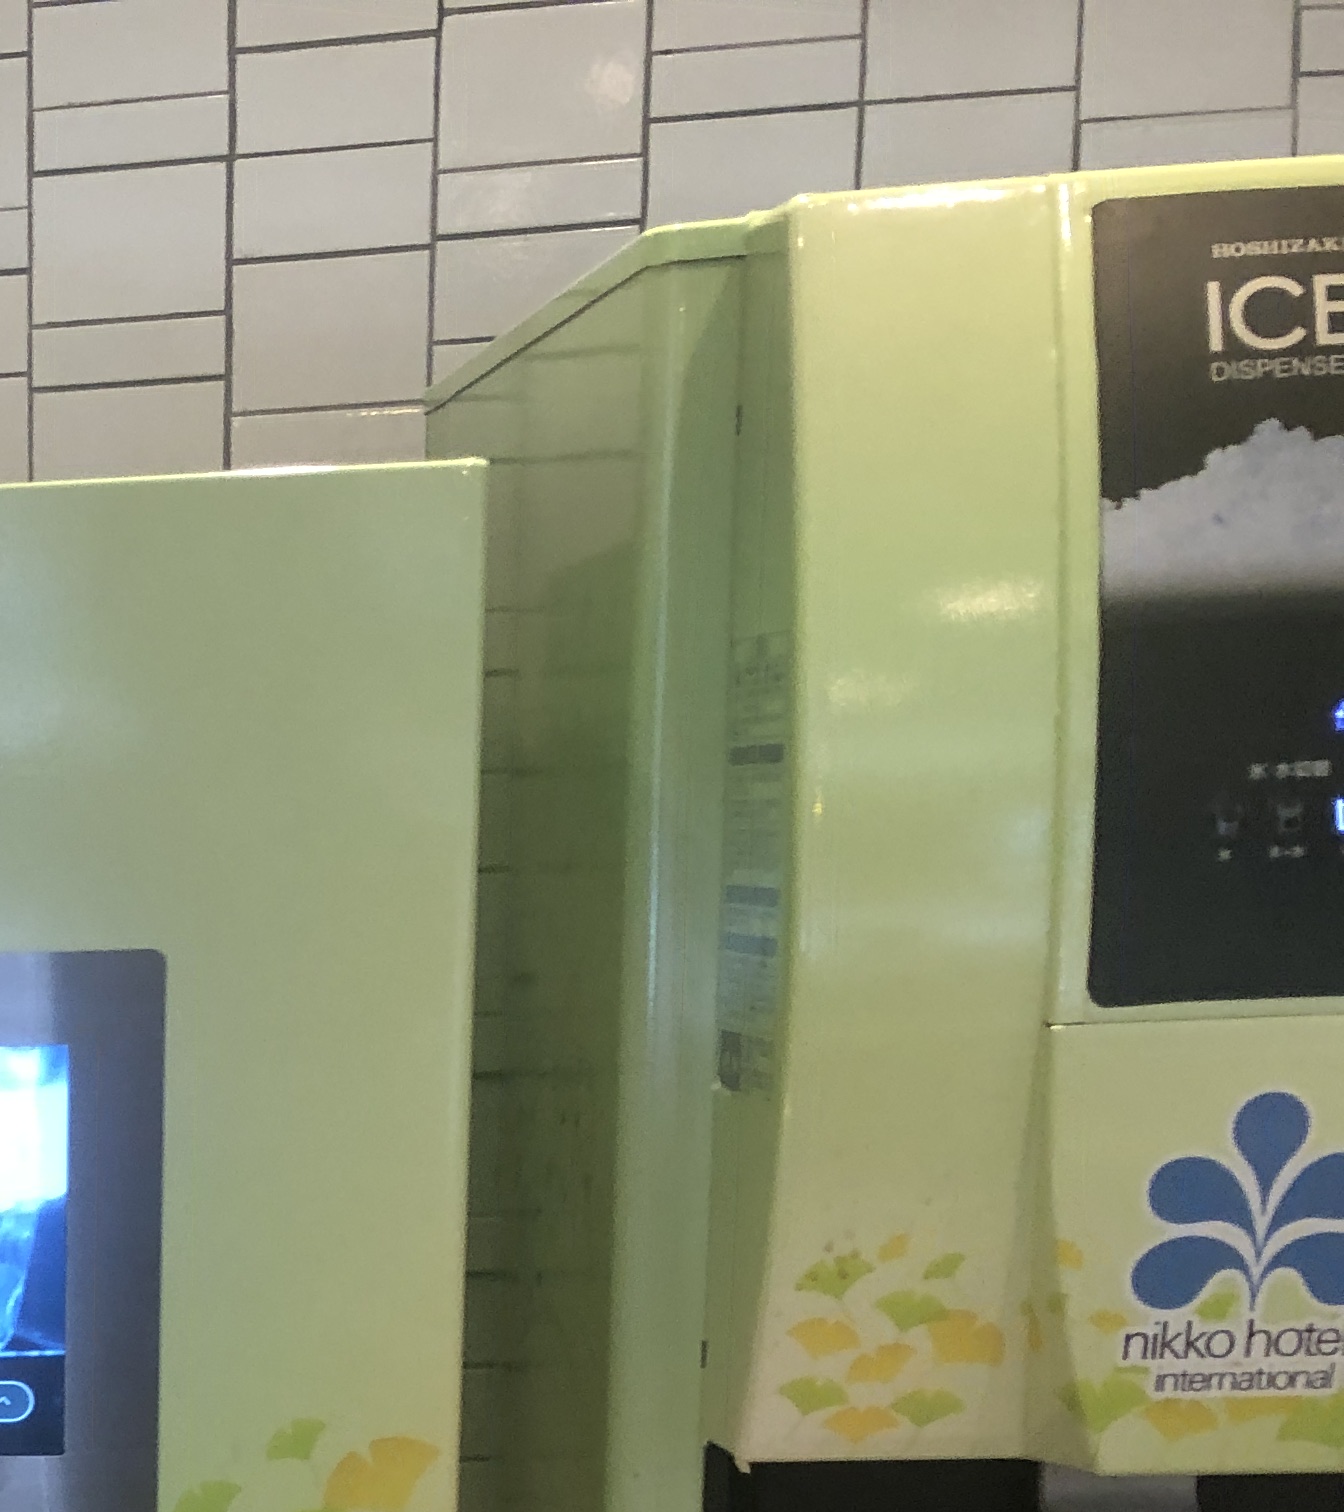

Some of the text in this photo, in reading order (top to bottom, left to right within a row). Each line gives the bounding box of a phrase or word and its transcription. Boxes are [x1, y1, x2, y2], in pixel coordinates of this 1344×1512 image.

[1207, 273, 1344, 352] ICE
[1121, 1318, 1344, 1361] nikko hote
[1154, 1362, 1336, 1393] international
